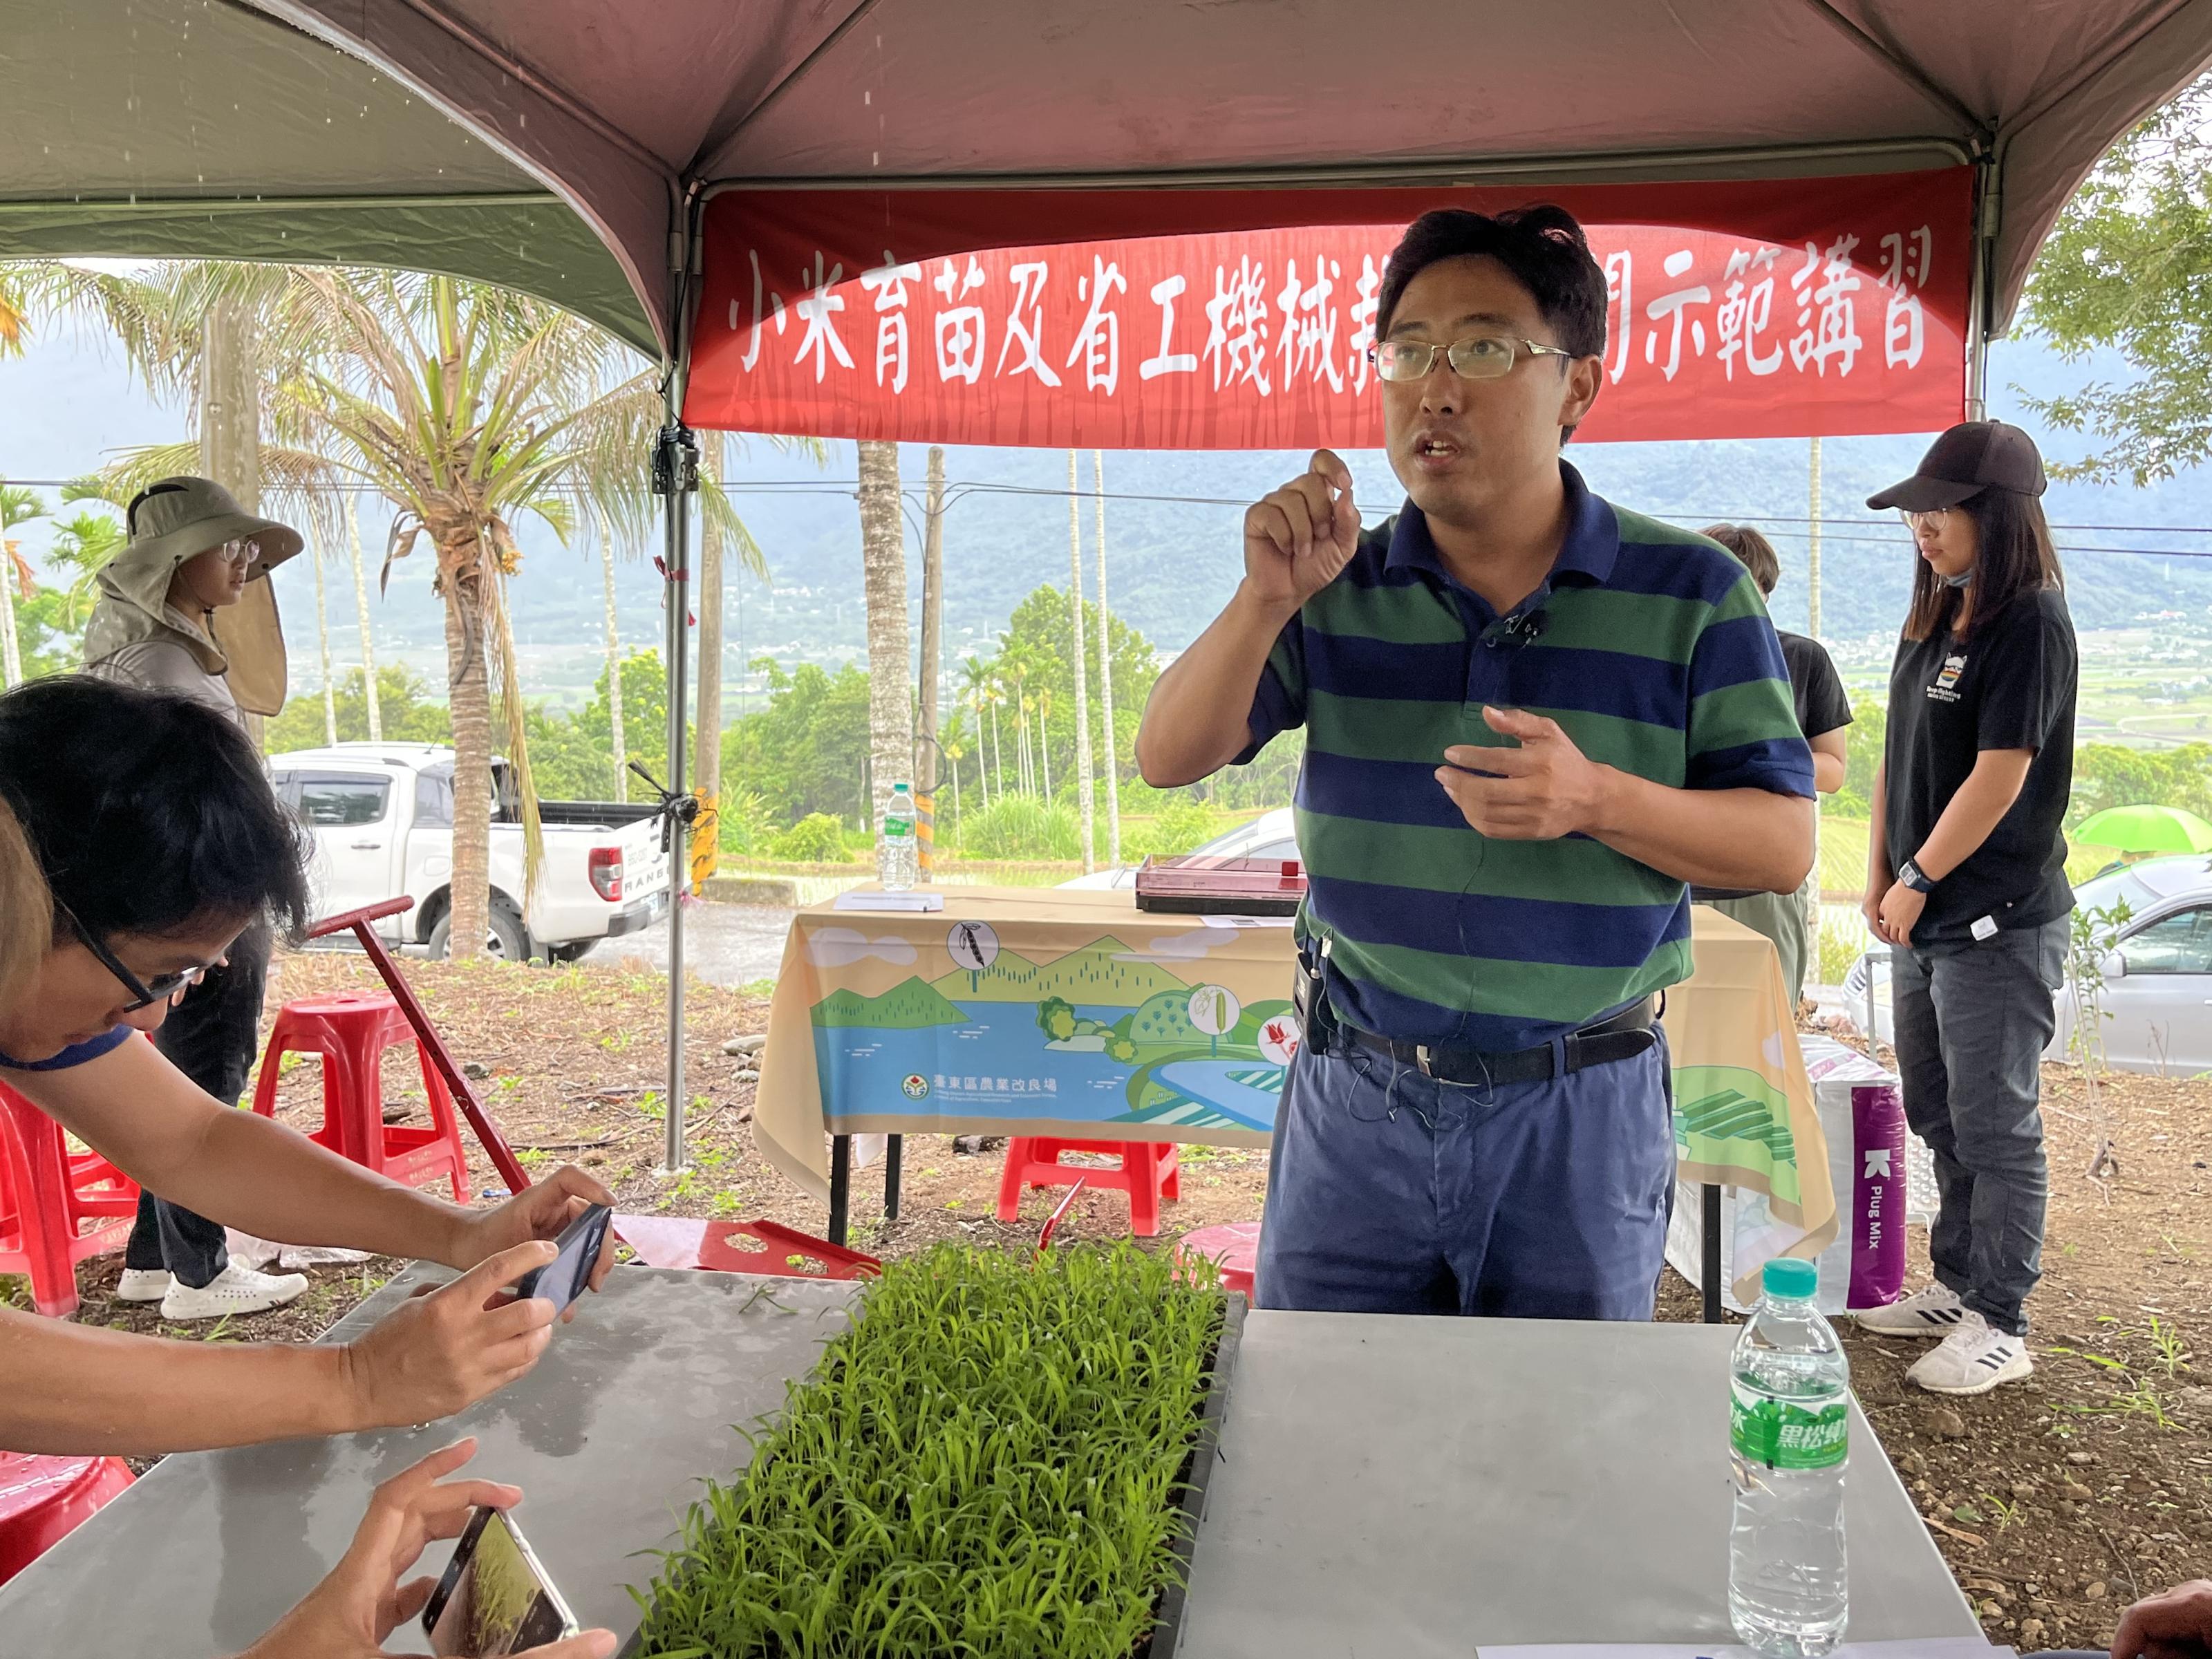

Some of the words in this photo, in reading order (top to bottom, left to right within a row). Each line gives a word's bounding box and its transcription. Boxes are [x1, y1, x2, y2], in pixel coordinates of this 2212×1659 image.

[729, 224, 1931, 397] 小米育苗及省工機械示範講習
[934, 1074, 1057, 1091] 臺東區農業改良場
[1868, 1185, 1882, 1218] Plug
[1868, 1221, 1882, 1250] Mix
